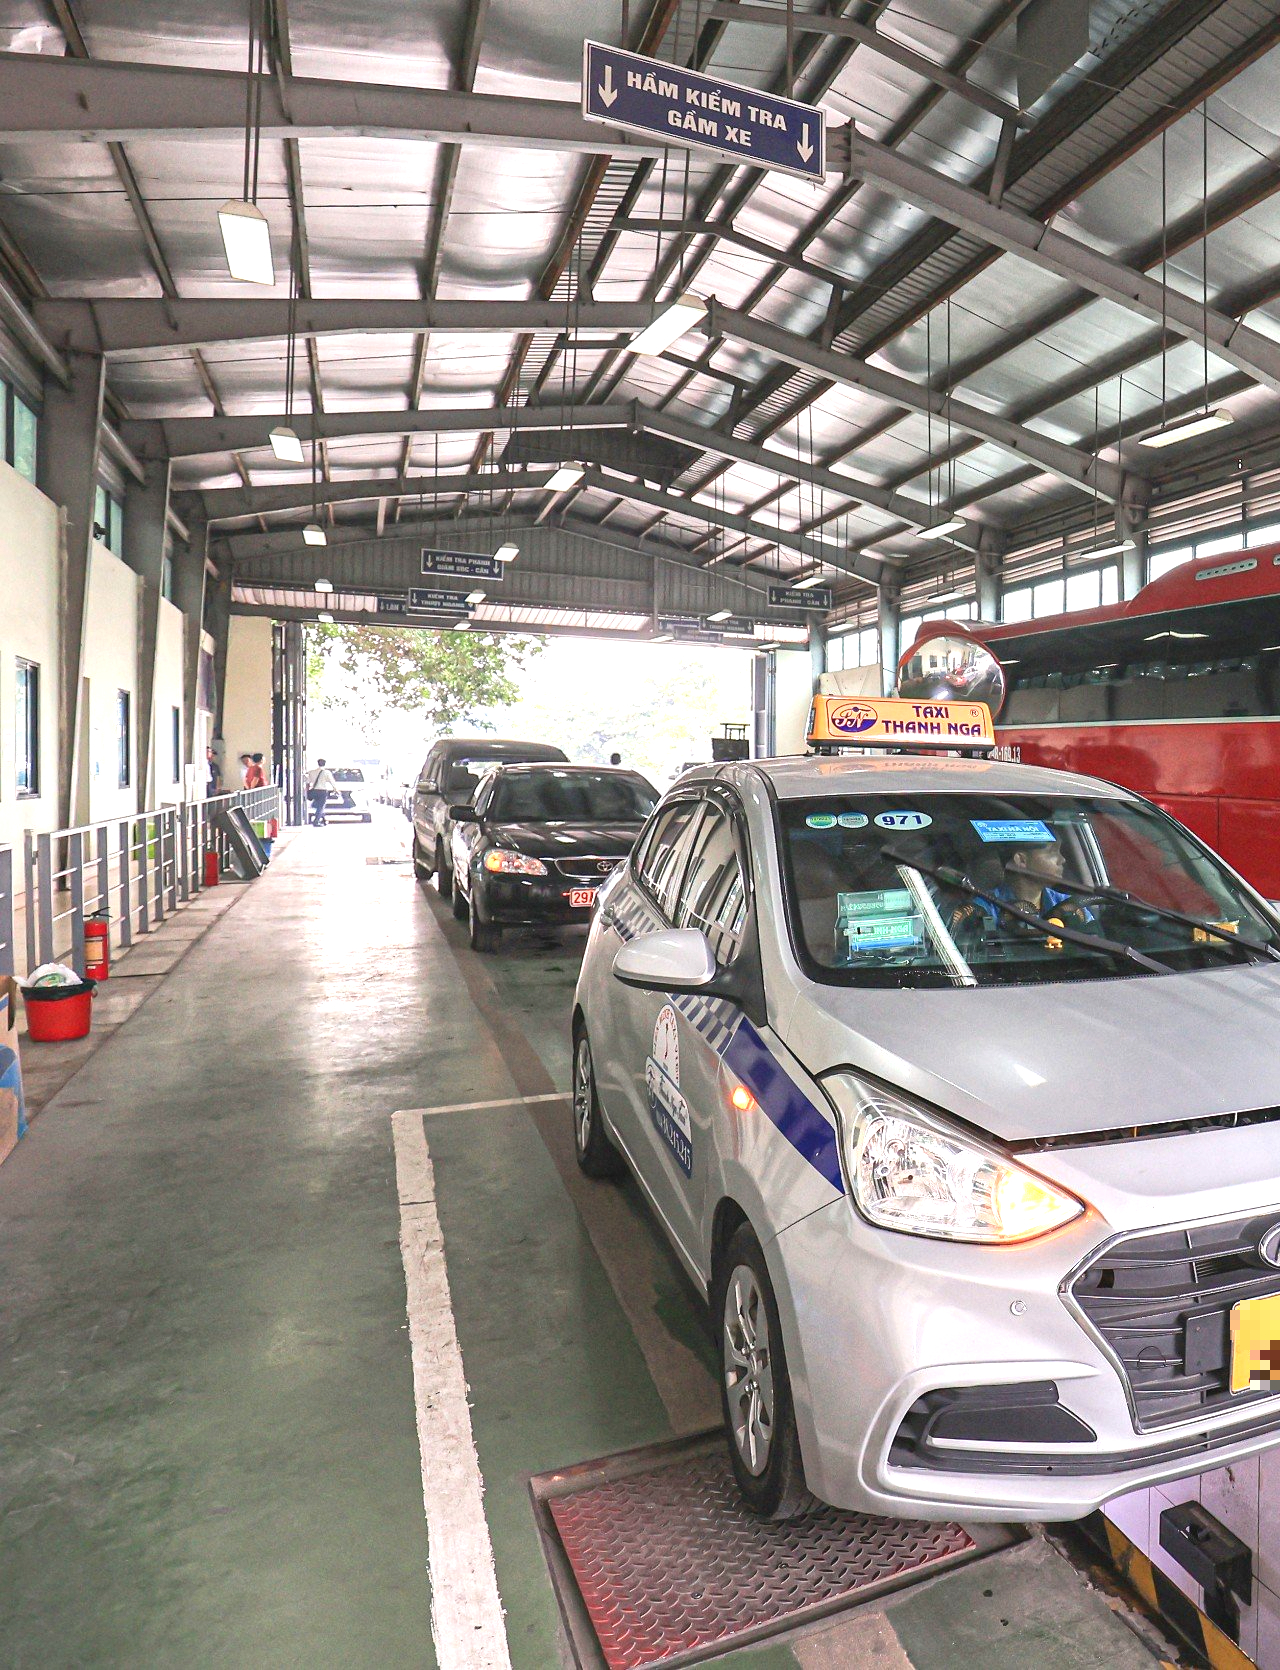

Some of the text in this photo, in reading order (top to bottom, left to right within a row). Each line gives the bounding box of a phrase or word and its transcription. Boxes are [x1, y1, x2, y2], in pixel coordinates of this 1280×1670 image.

[627, 71, 787, 132] HẦM KIỂM TRA
[668, 109, 752, 147] GẦM XE
[912, 705, 949, 719] TAXI
[882, 720, 981, 736] THANH NGA
[881, 815, 922, 825] 971
